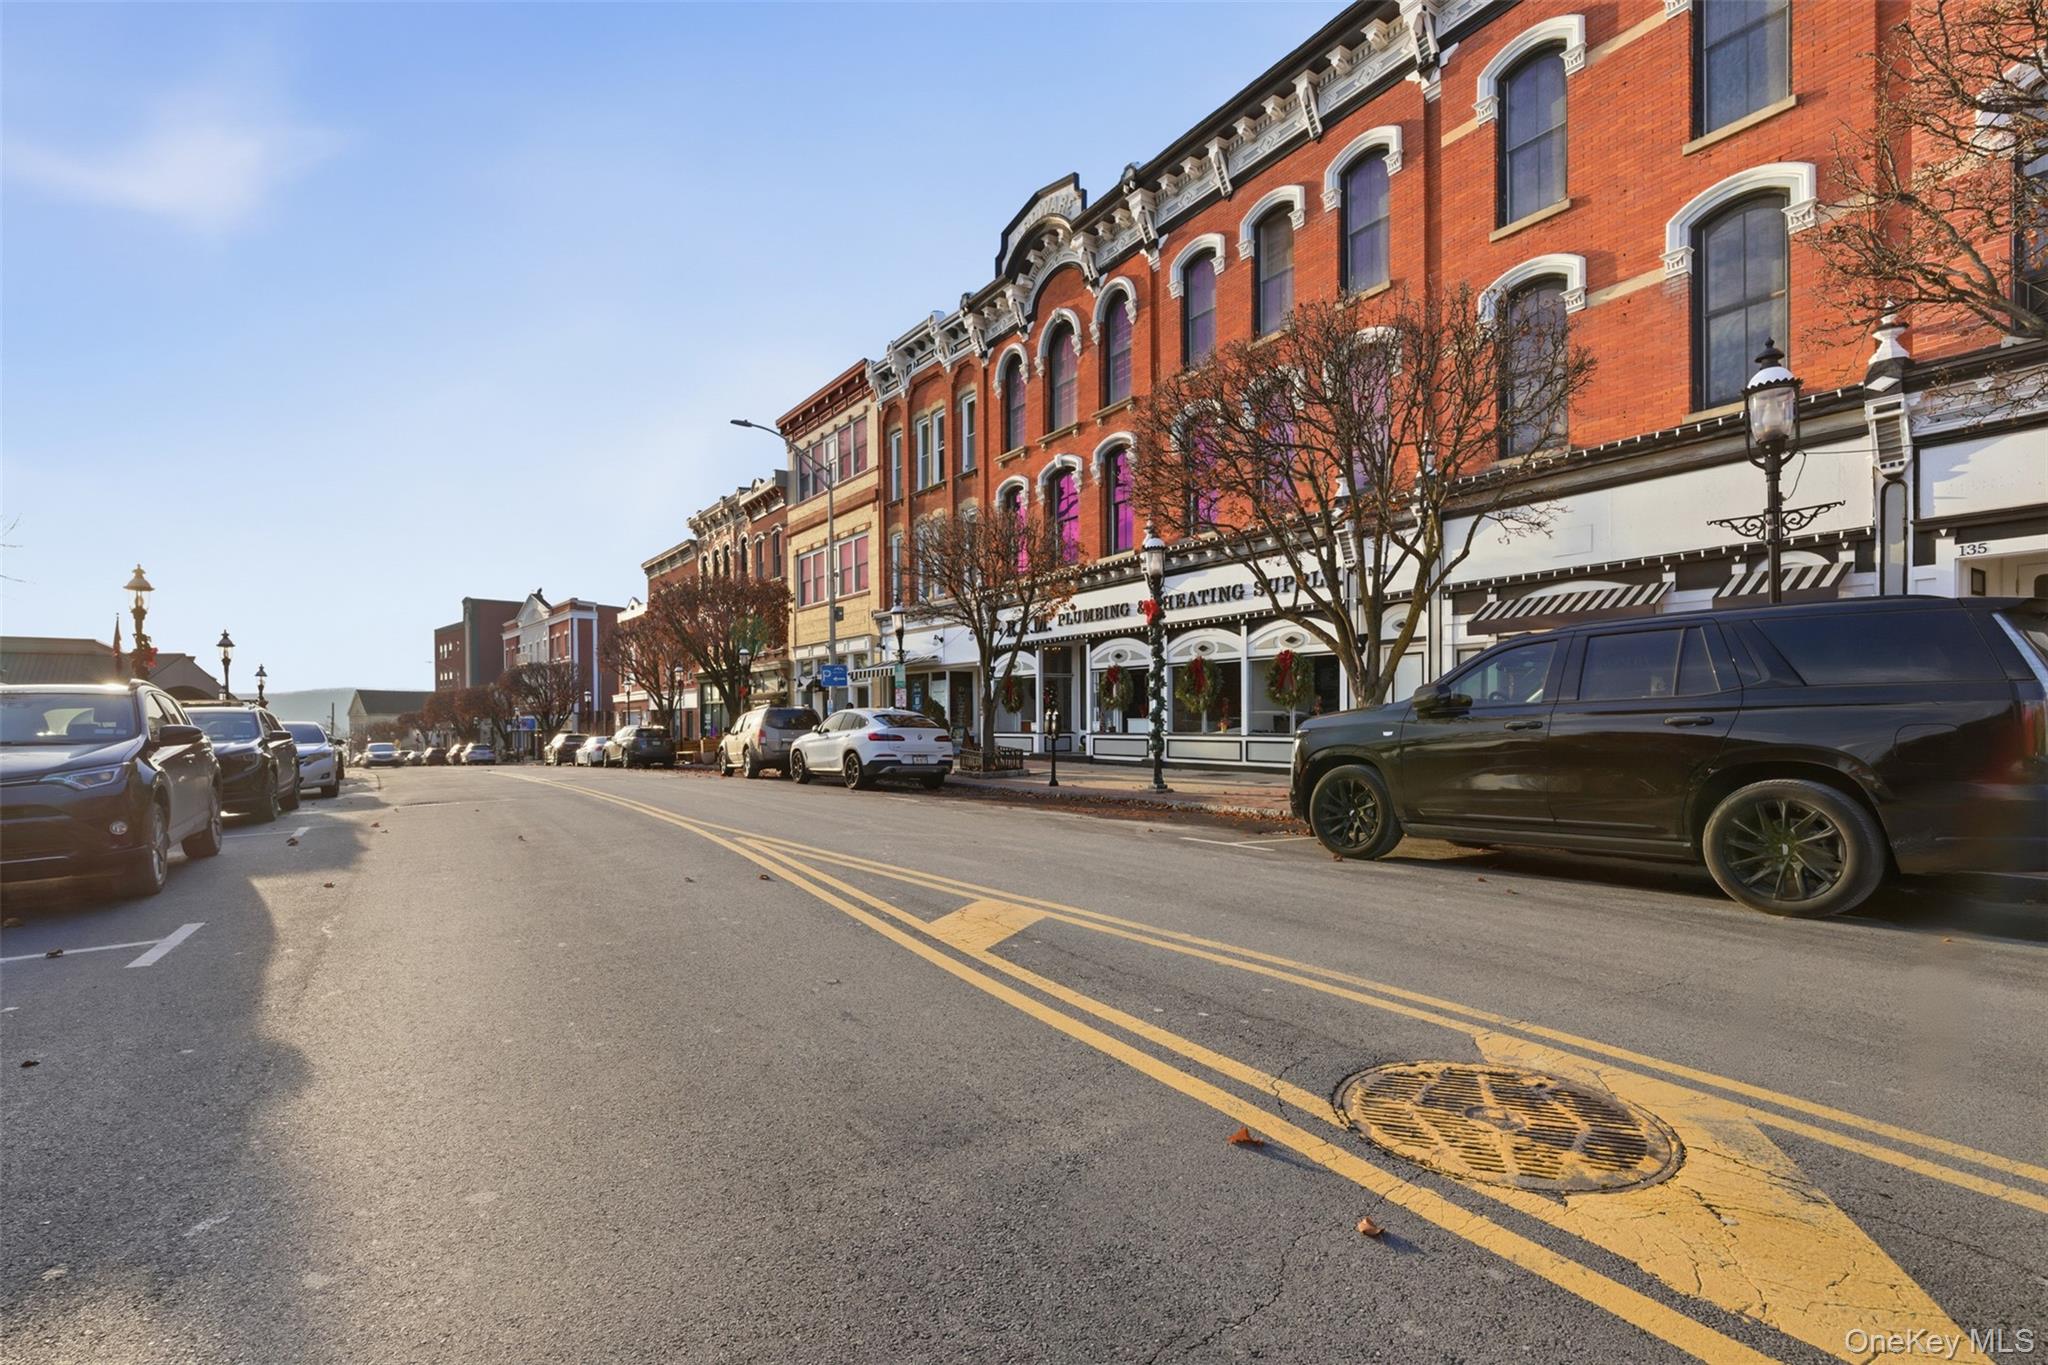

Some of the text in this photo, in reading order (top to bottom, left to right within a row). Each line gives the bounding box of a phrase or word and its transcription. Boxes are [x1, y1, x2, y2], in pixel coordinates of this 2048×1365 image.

[1959, 542, 1988, 556] 135
[1057, 602, 1130, 626] PLUMBING
[1162, 583, 1245, 610] HEATING
